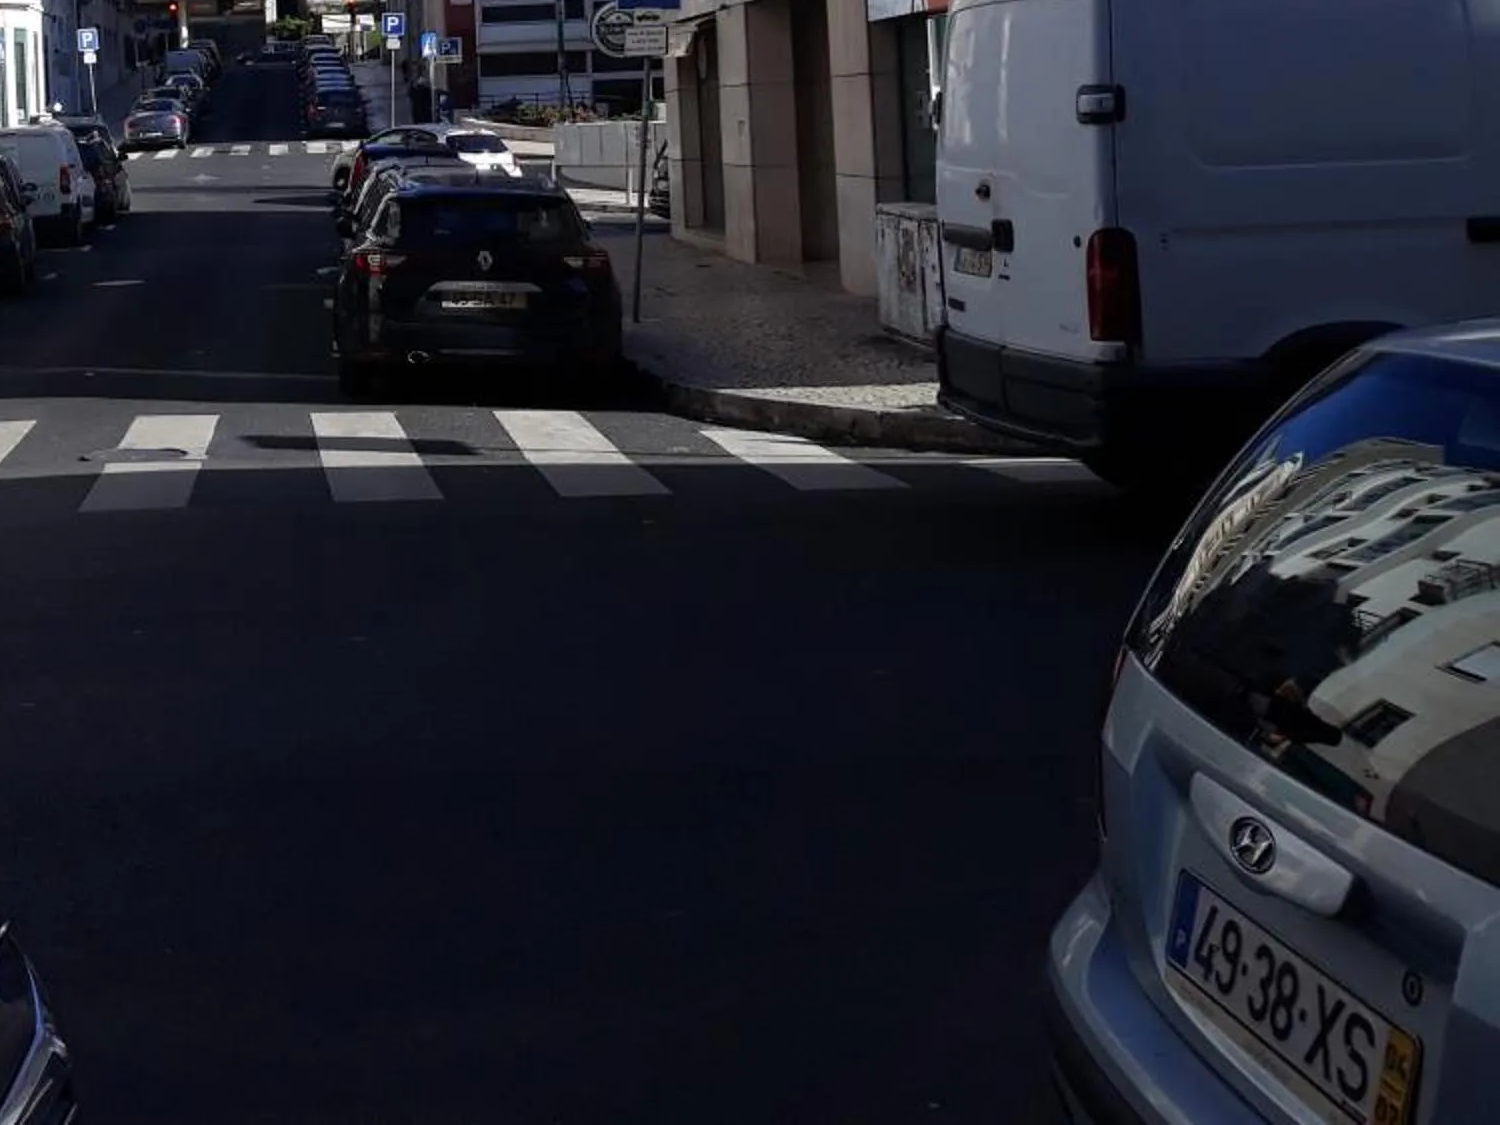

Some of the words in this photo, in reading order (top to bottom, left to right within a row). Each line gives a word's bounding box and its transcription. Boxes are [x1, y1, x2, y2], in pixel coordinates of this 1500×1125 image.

[386, 16, 399, 32] P
[81, 32, 93, 48] P
[441, 42, 452, 55] P
